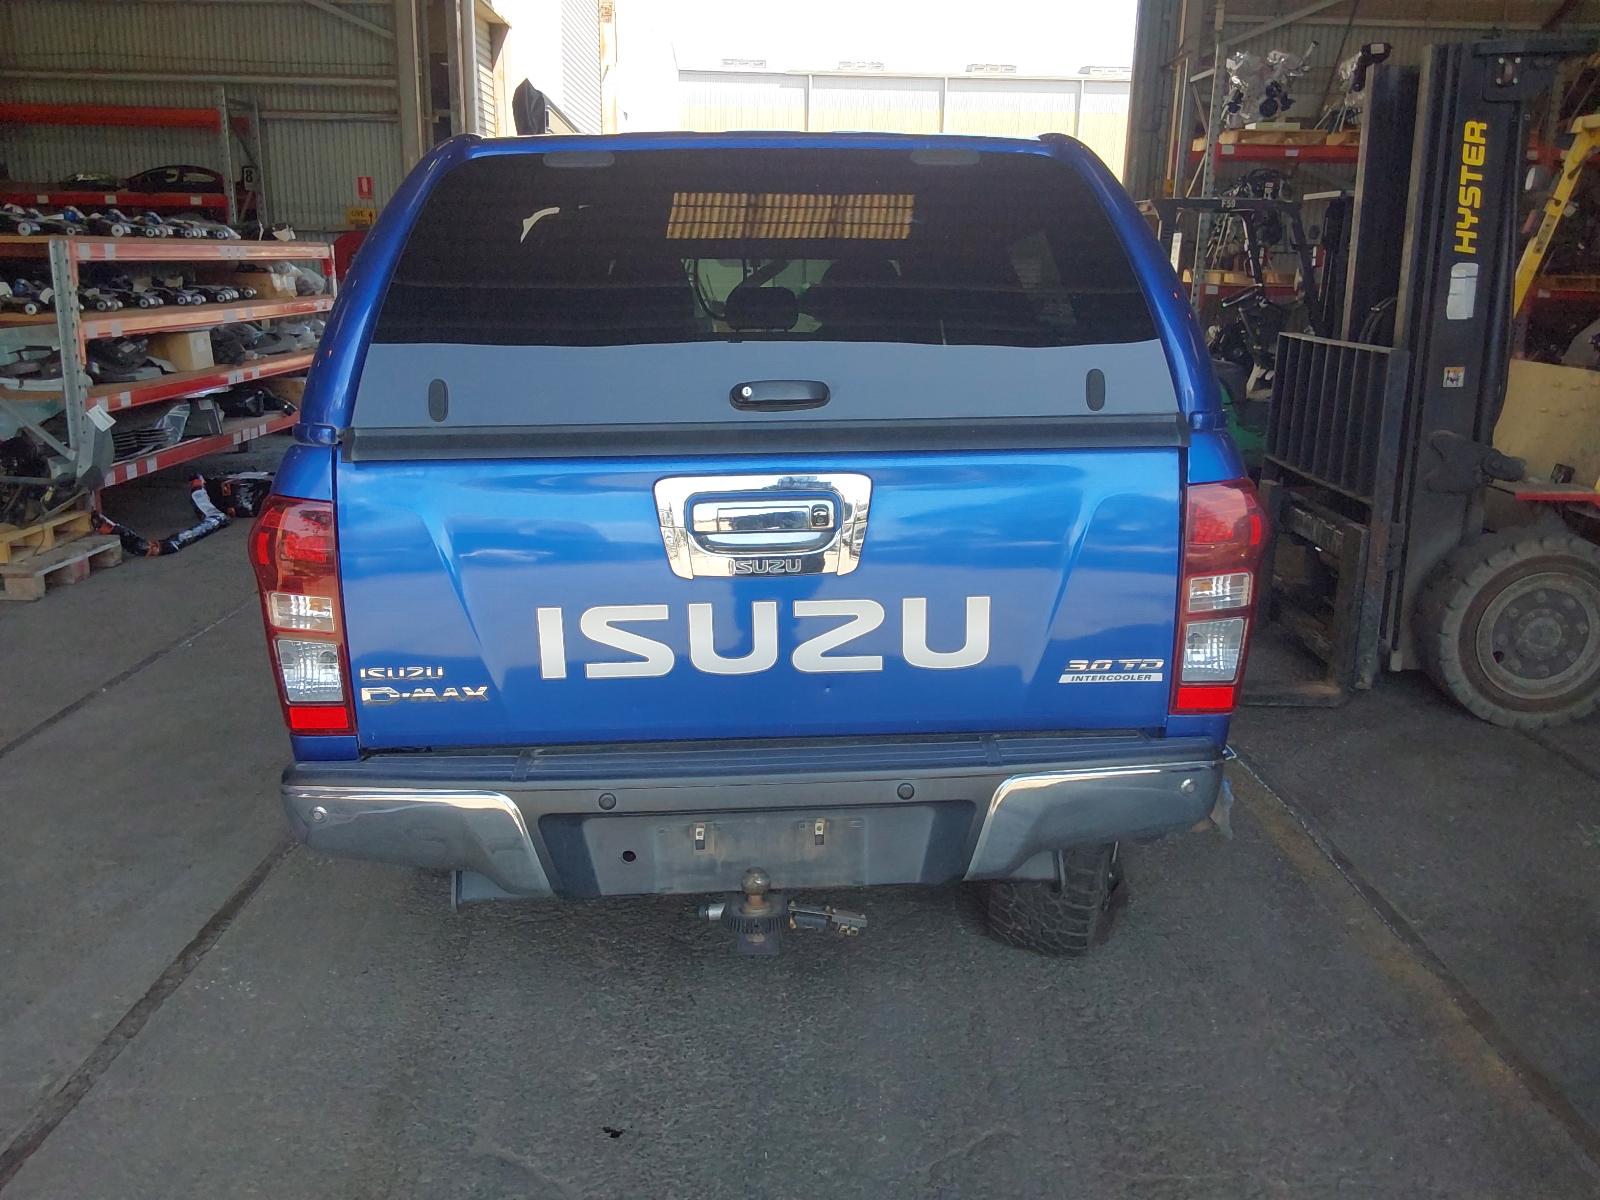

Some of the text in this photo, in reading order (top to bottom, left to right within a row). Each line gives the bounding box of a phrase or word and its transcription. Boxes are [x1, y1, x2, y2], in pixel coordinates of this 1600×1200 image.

[1454, 120, 1487, 254] HYSTER
[728, 558, 802, 575] ISUZU
[537, 596, 991, 679] ISUZU
[360, 666, 444, 680] ISUZU
[1118, 658, 1165, 671] TD
[1071, 674, 1152, 682] INTERCOOLER
[361, 686, 489, 703] D-MAX
